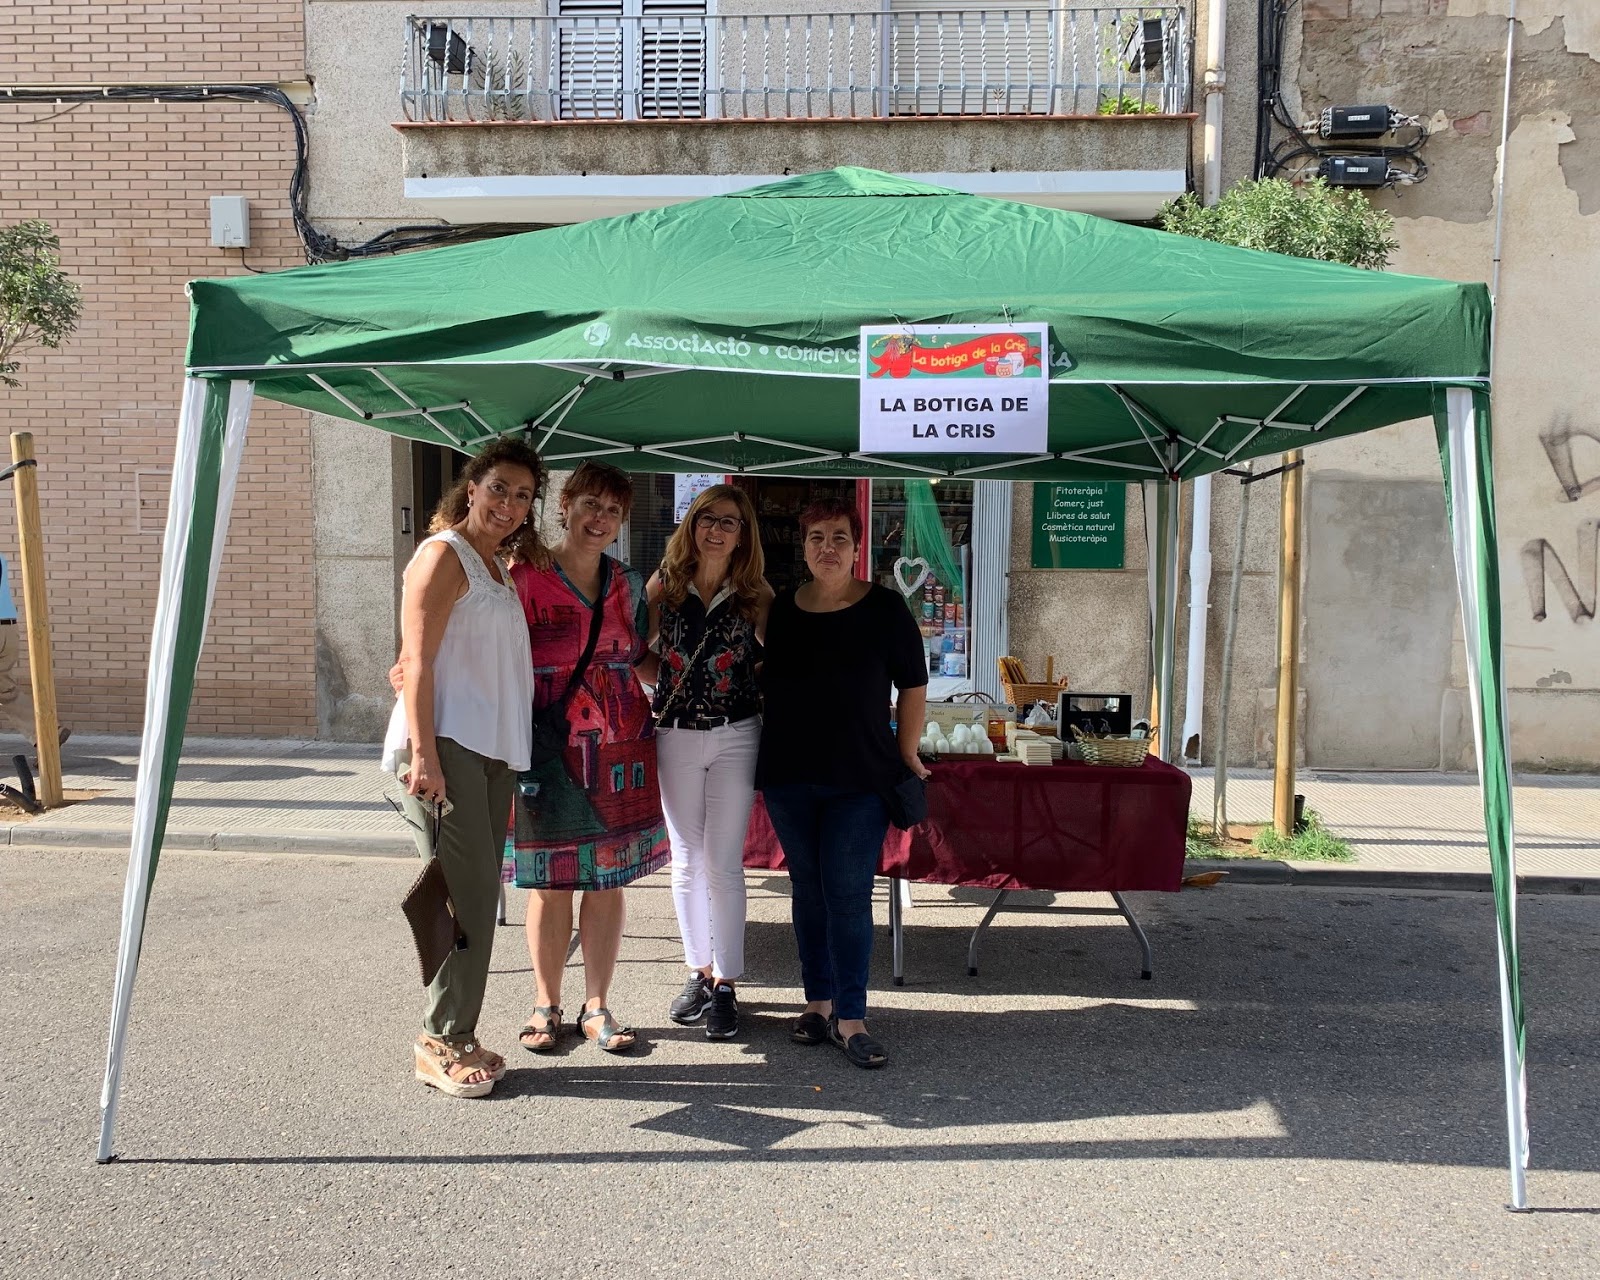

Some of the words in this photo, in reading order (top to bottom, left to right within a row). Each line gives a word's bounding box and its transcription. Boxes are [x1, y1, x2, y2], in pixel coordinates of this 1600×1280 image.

[912, 351, 927, 365] La
[930, 354, 968, 368] botiga
[972, 347, 987, 359] de
[990, 342, 1001, 354] la
[1004, 338, 1026, 353] Cris
[880, 398, 906, 412] LA
[913, 397, 994, 412] BOTIGA
[1001, 397, 1029, 412] DE
[912, 424, 939, 438] LA
[945, 423, 996, 439] CRIS
[1056, 486, 1103, 496] Fitoteràpia
[1053, 499, 1085, 509] Comerç
[1086, 499, 1104, 509] just
[1046, 511, 1076, 520] Llibres
[1077, 511, 1089, 520] de
[1090, 511, 1111, 520] salut
[1041, 522, 1084, 531] Cosmètica
[1085, 523, 1116, 531] natural
[1048, 534, 1108, 544] Musicoteràpia
